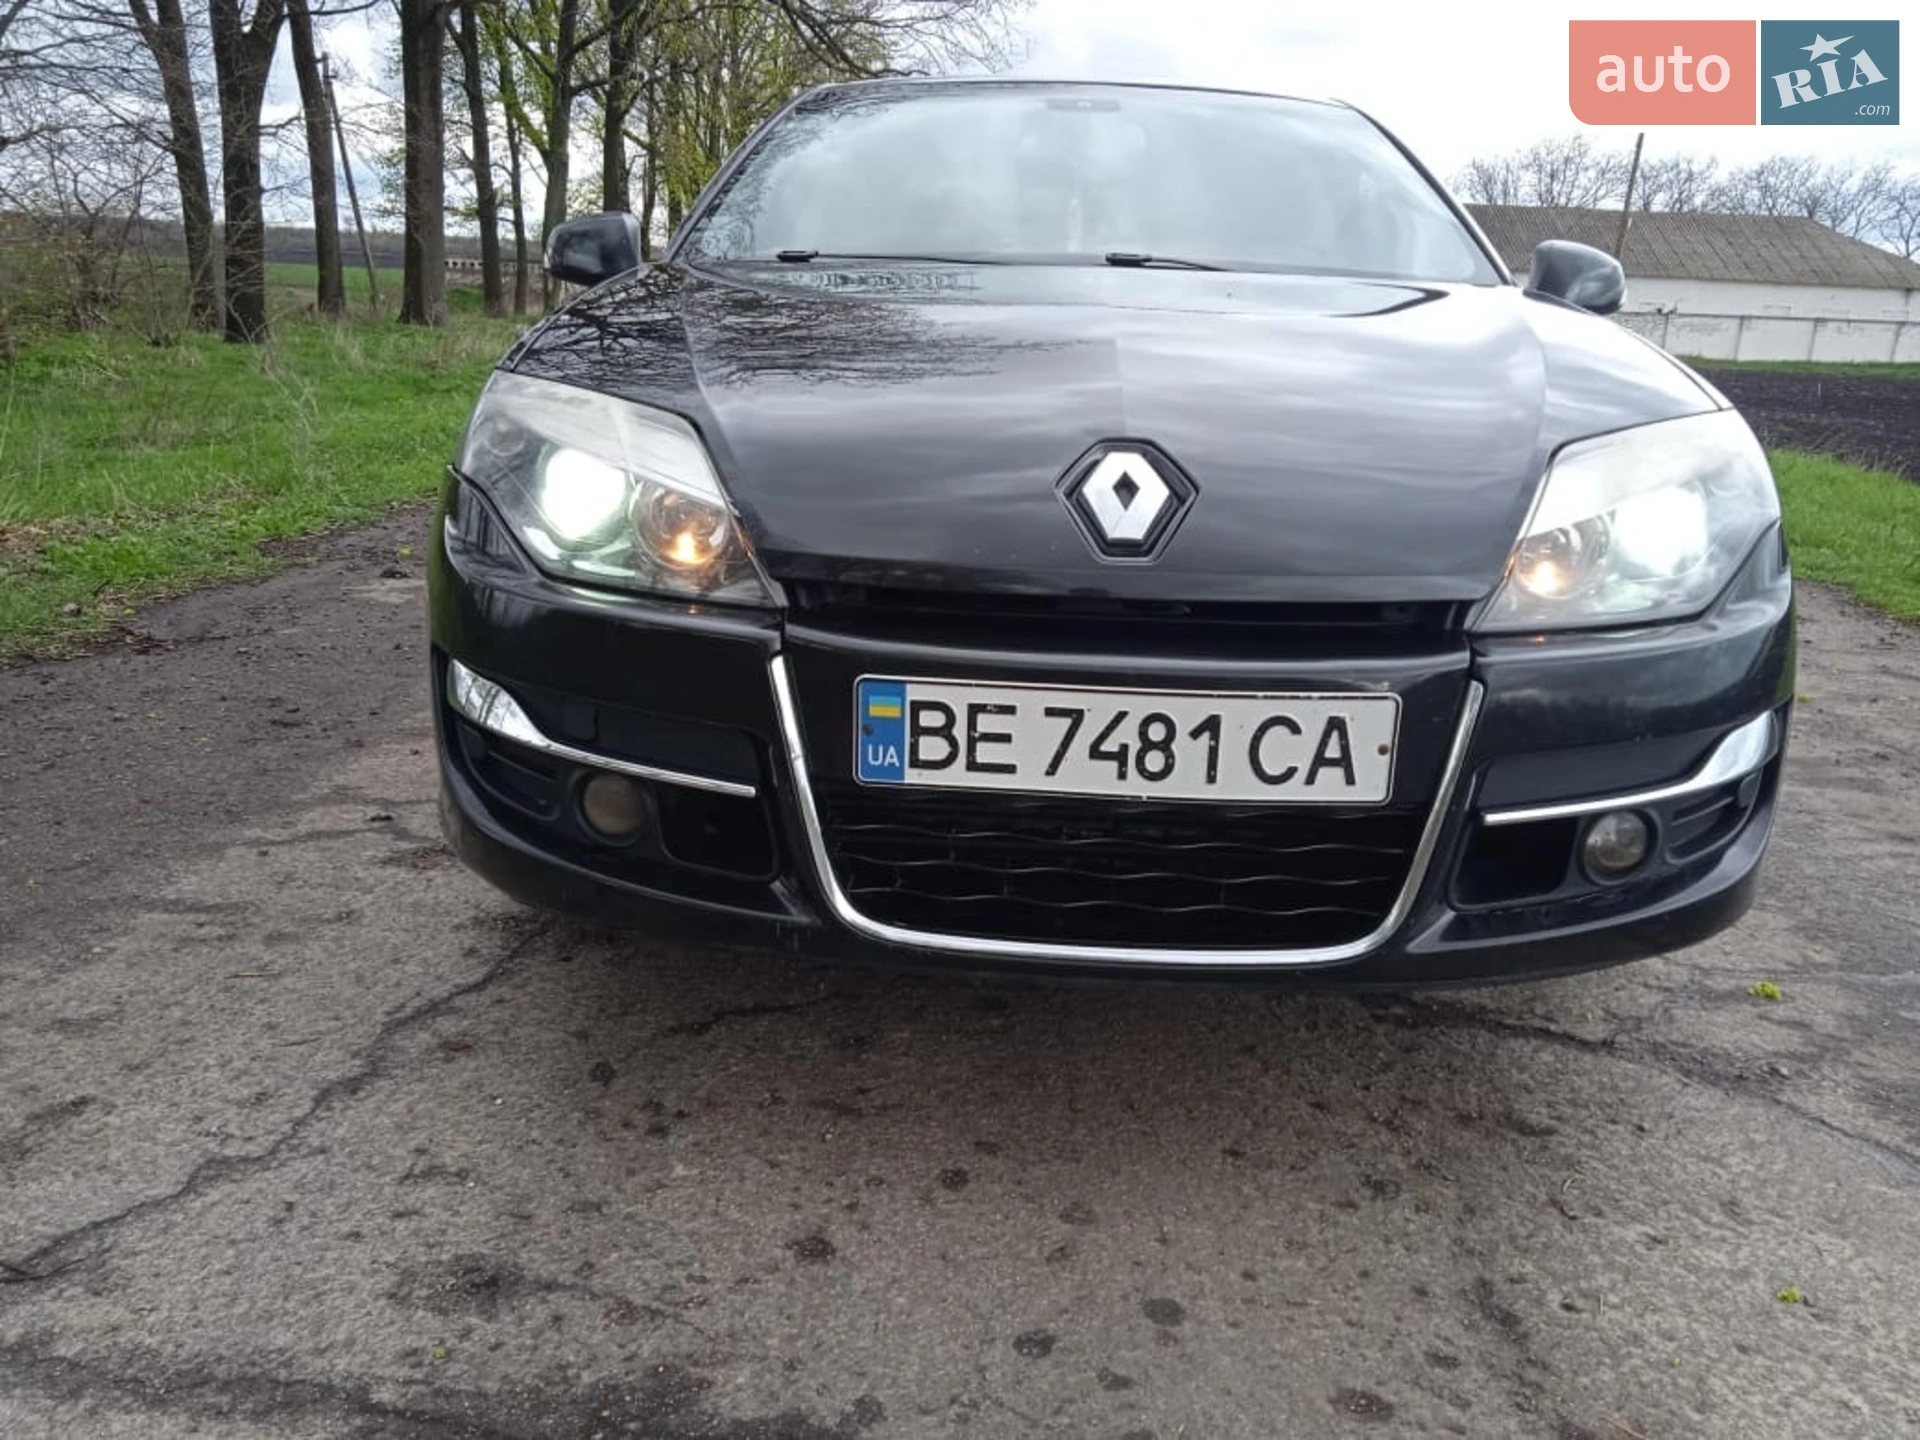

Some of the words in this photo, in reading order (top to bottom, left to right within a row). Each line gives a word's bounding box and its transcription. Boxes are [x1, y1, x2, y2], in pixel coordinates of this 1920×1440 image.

[867, 744, 900, 768] UA
[908, 698, 1018, 774] BE
[1043, 705, 1223, 784] 7481
[1248, 714, 1357, 786] CA
